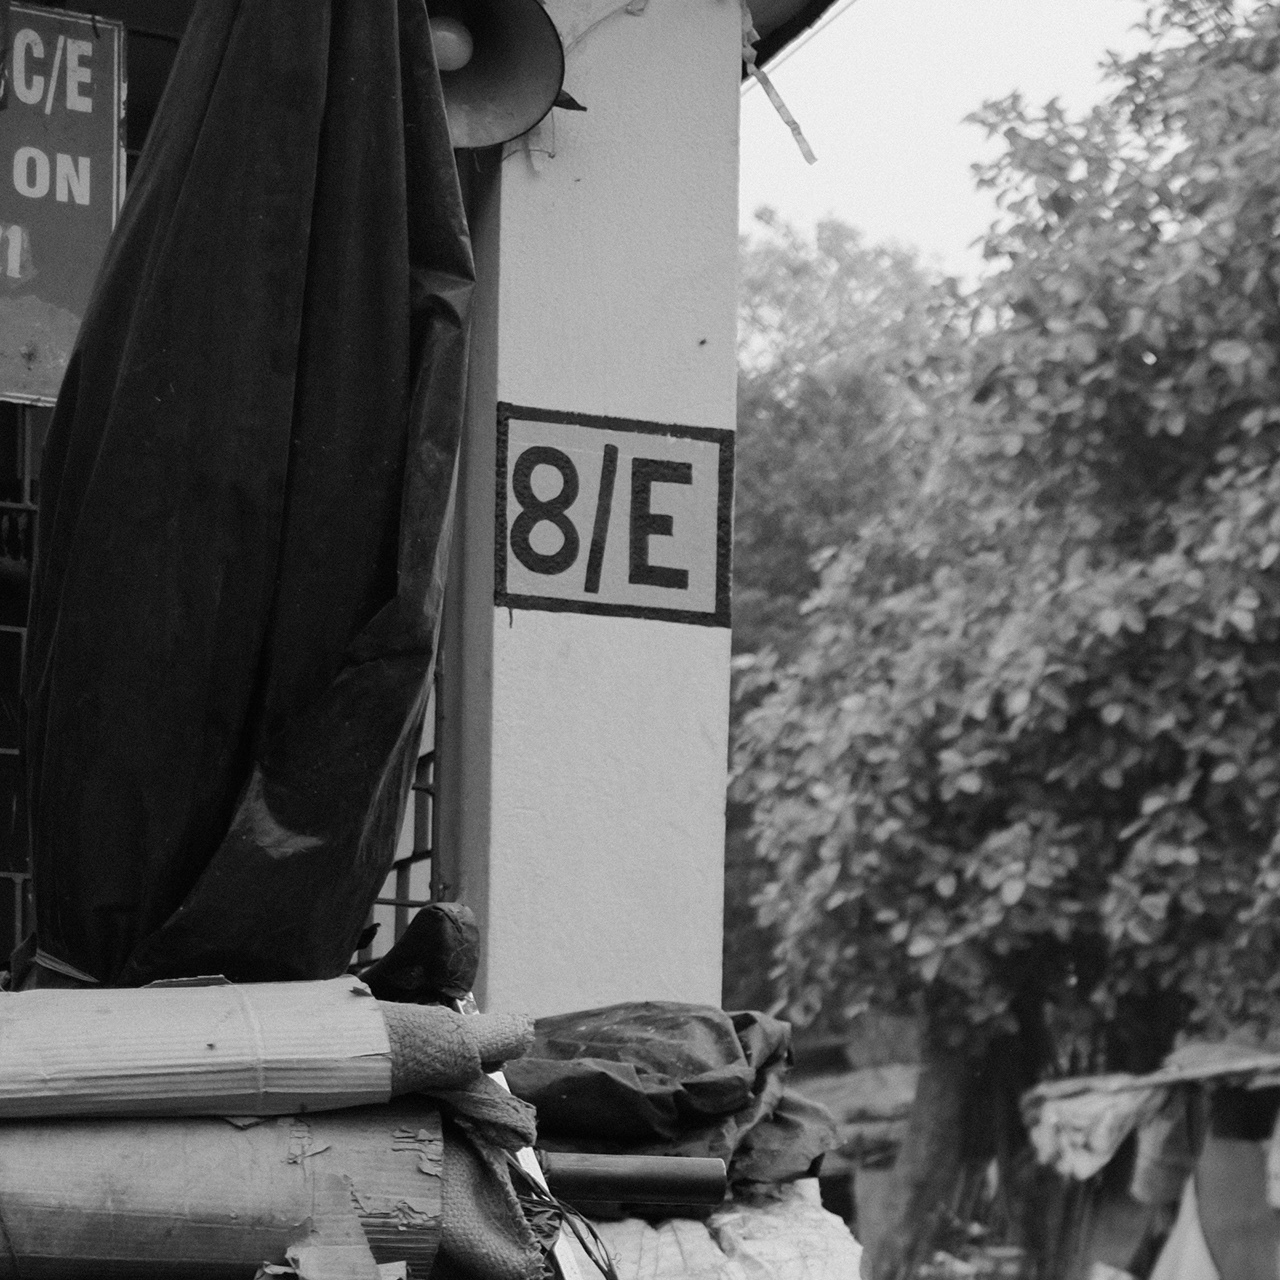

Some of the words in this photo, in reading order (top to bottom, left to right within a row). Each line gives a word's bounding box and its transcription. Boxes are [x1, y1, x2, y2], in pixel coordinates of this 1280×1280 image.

[12, 28, 93, 115] C/E
[13, 146, 91, 206] ON
[509, 443, 693, 594] 8/E
